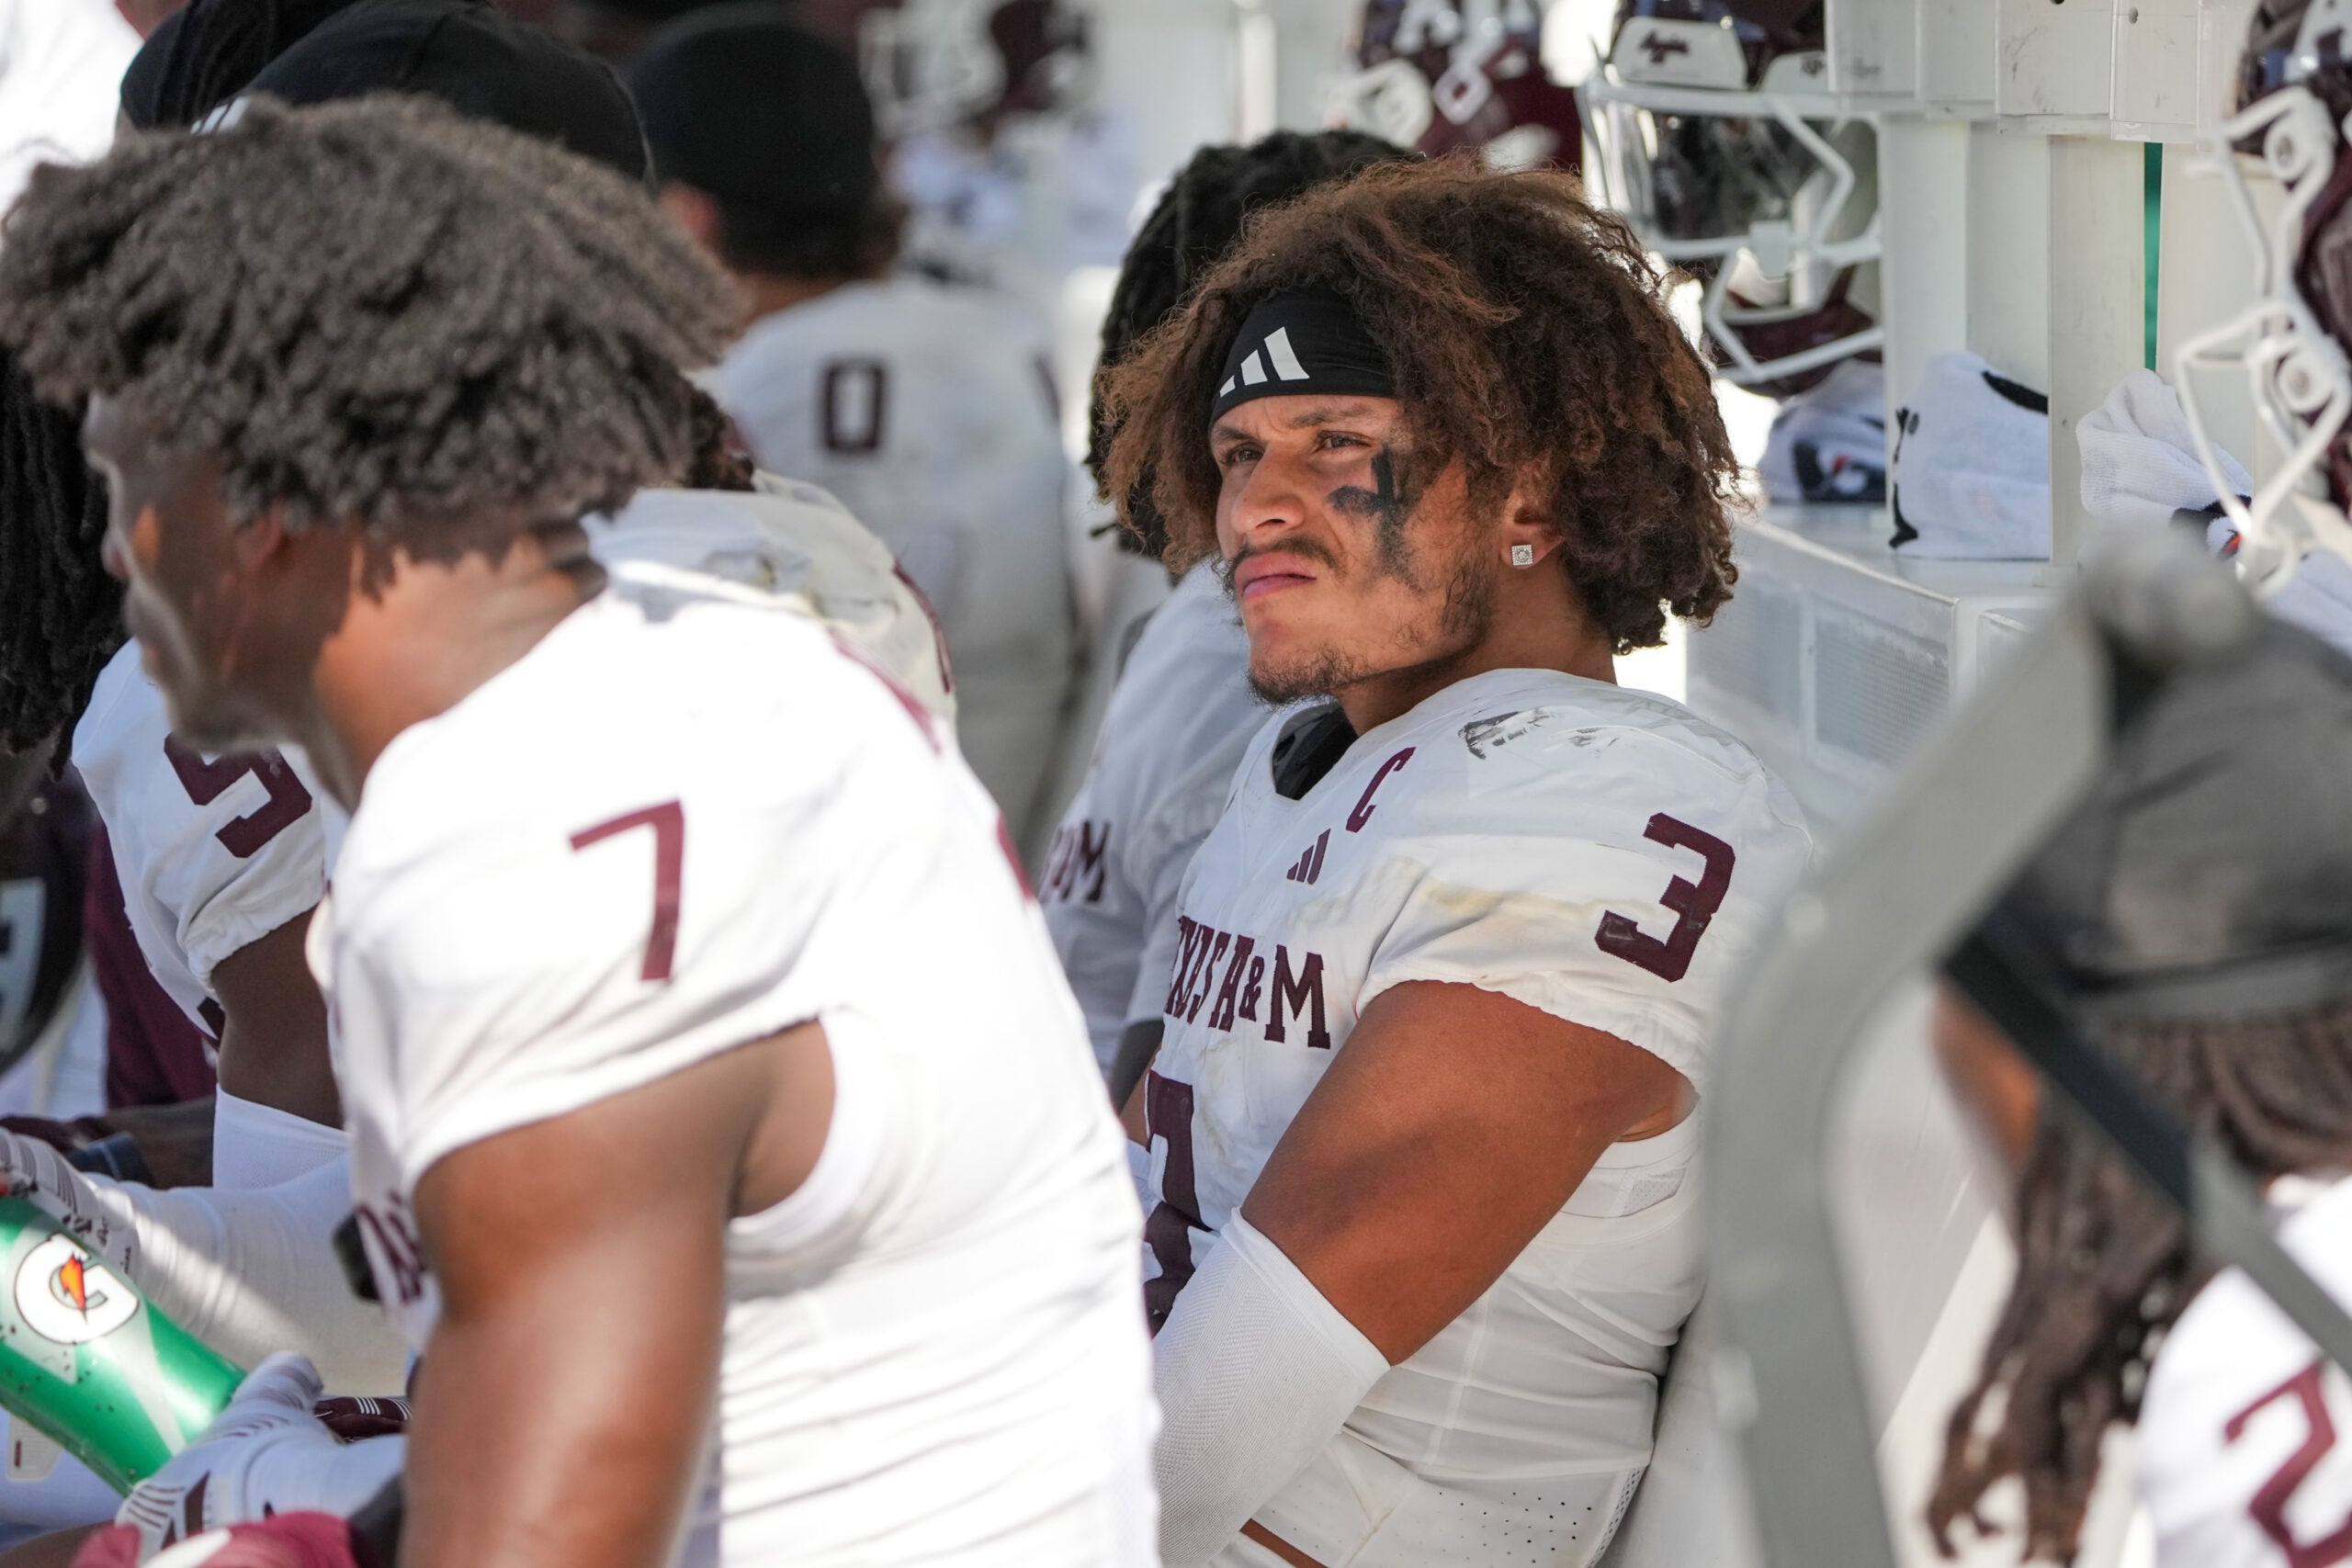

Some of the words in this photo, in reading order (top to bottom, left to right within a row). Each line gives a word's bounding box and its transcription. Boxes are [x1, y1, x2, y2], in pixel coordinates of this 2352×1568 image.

[820, 357, 890, 457] 0
[1345, 746, 1417, 834] C
[569, 797, 685, 981] 7
[1594, 812, 1736, 984] 3
[1207, 933, 1331, 1050] A&M
[14, 1233, 140, 1345] G
[2224, 1358, 2352, 1568] 2
